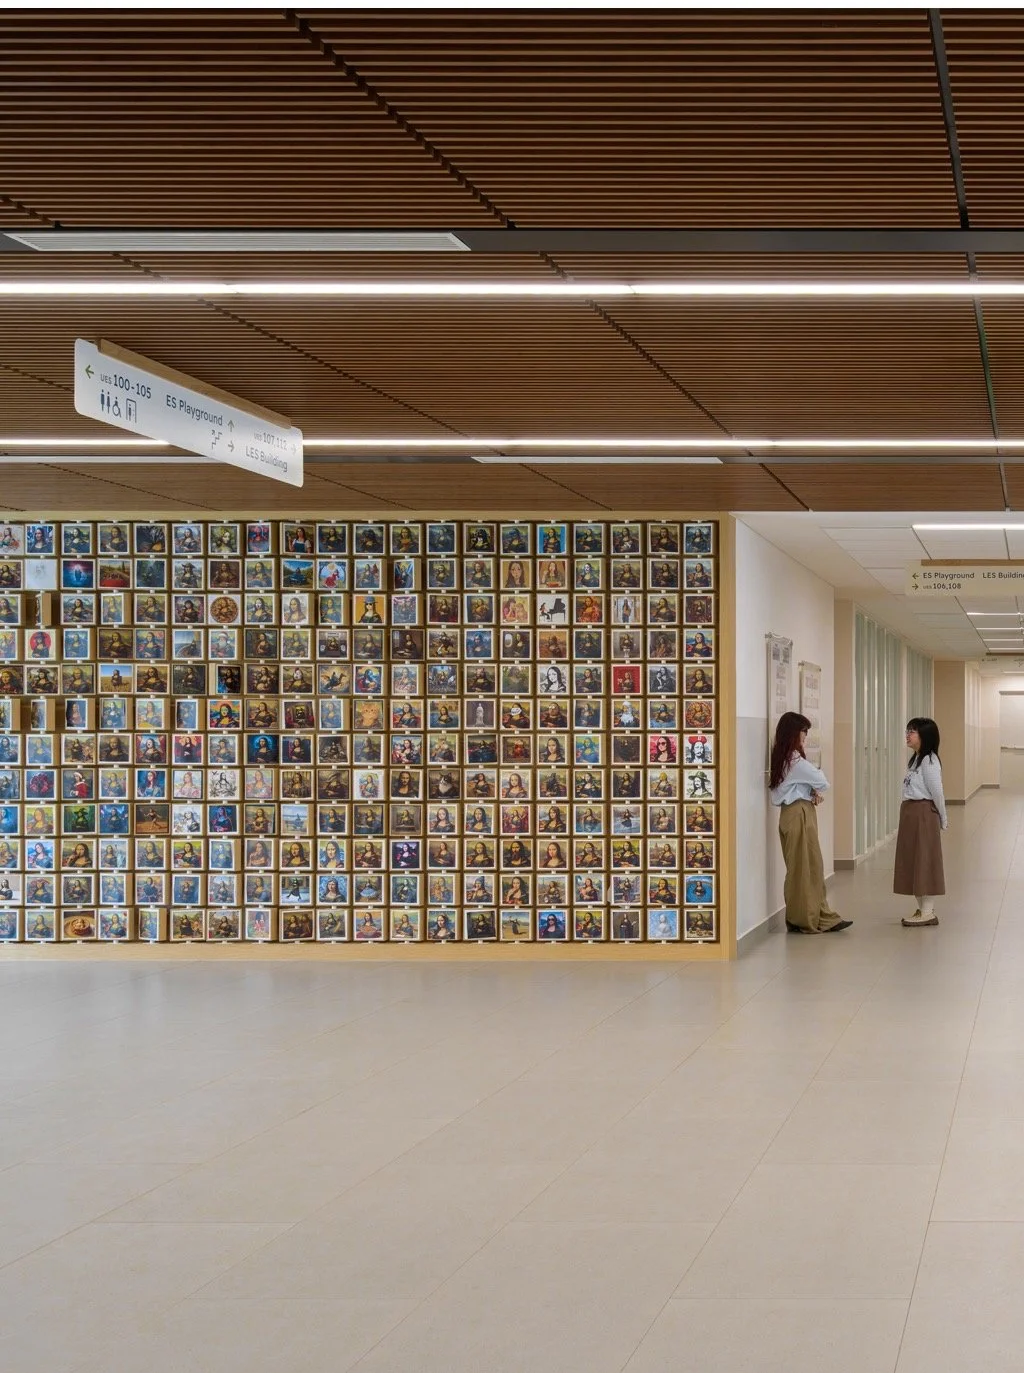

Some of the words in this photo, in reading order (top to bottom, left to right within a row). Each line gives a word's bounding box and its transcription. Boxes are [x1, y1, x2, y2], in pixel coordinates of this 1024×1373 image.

[100, 374, 112, 385] UES
[113, 374, 152, 399] 100-105
[166, 394, 176, 408] ES
[178, 401, 222, 426] Playground
[263, 432, 288, 452] 107,112
[246, 446, 260, 462] LES
[260, 451, 288, 472] Building
[934, 572, 974, 580] Playground
